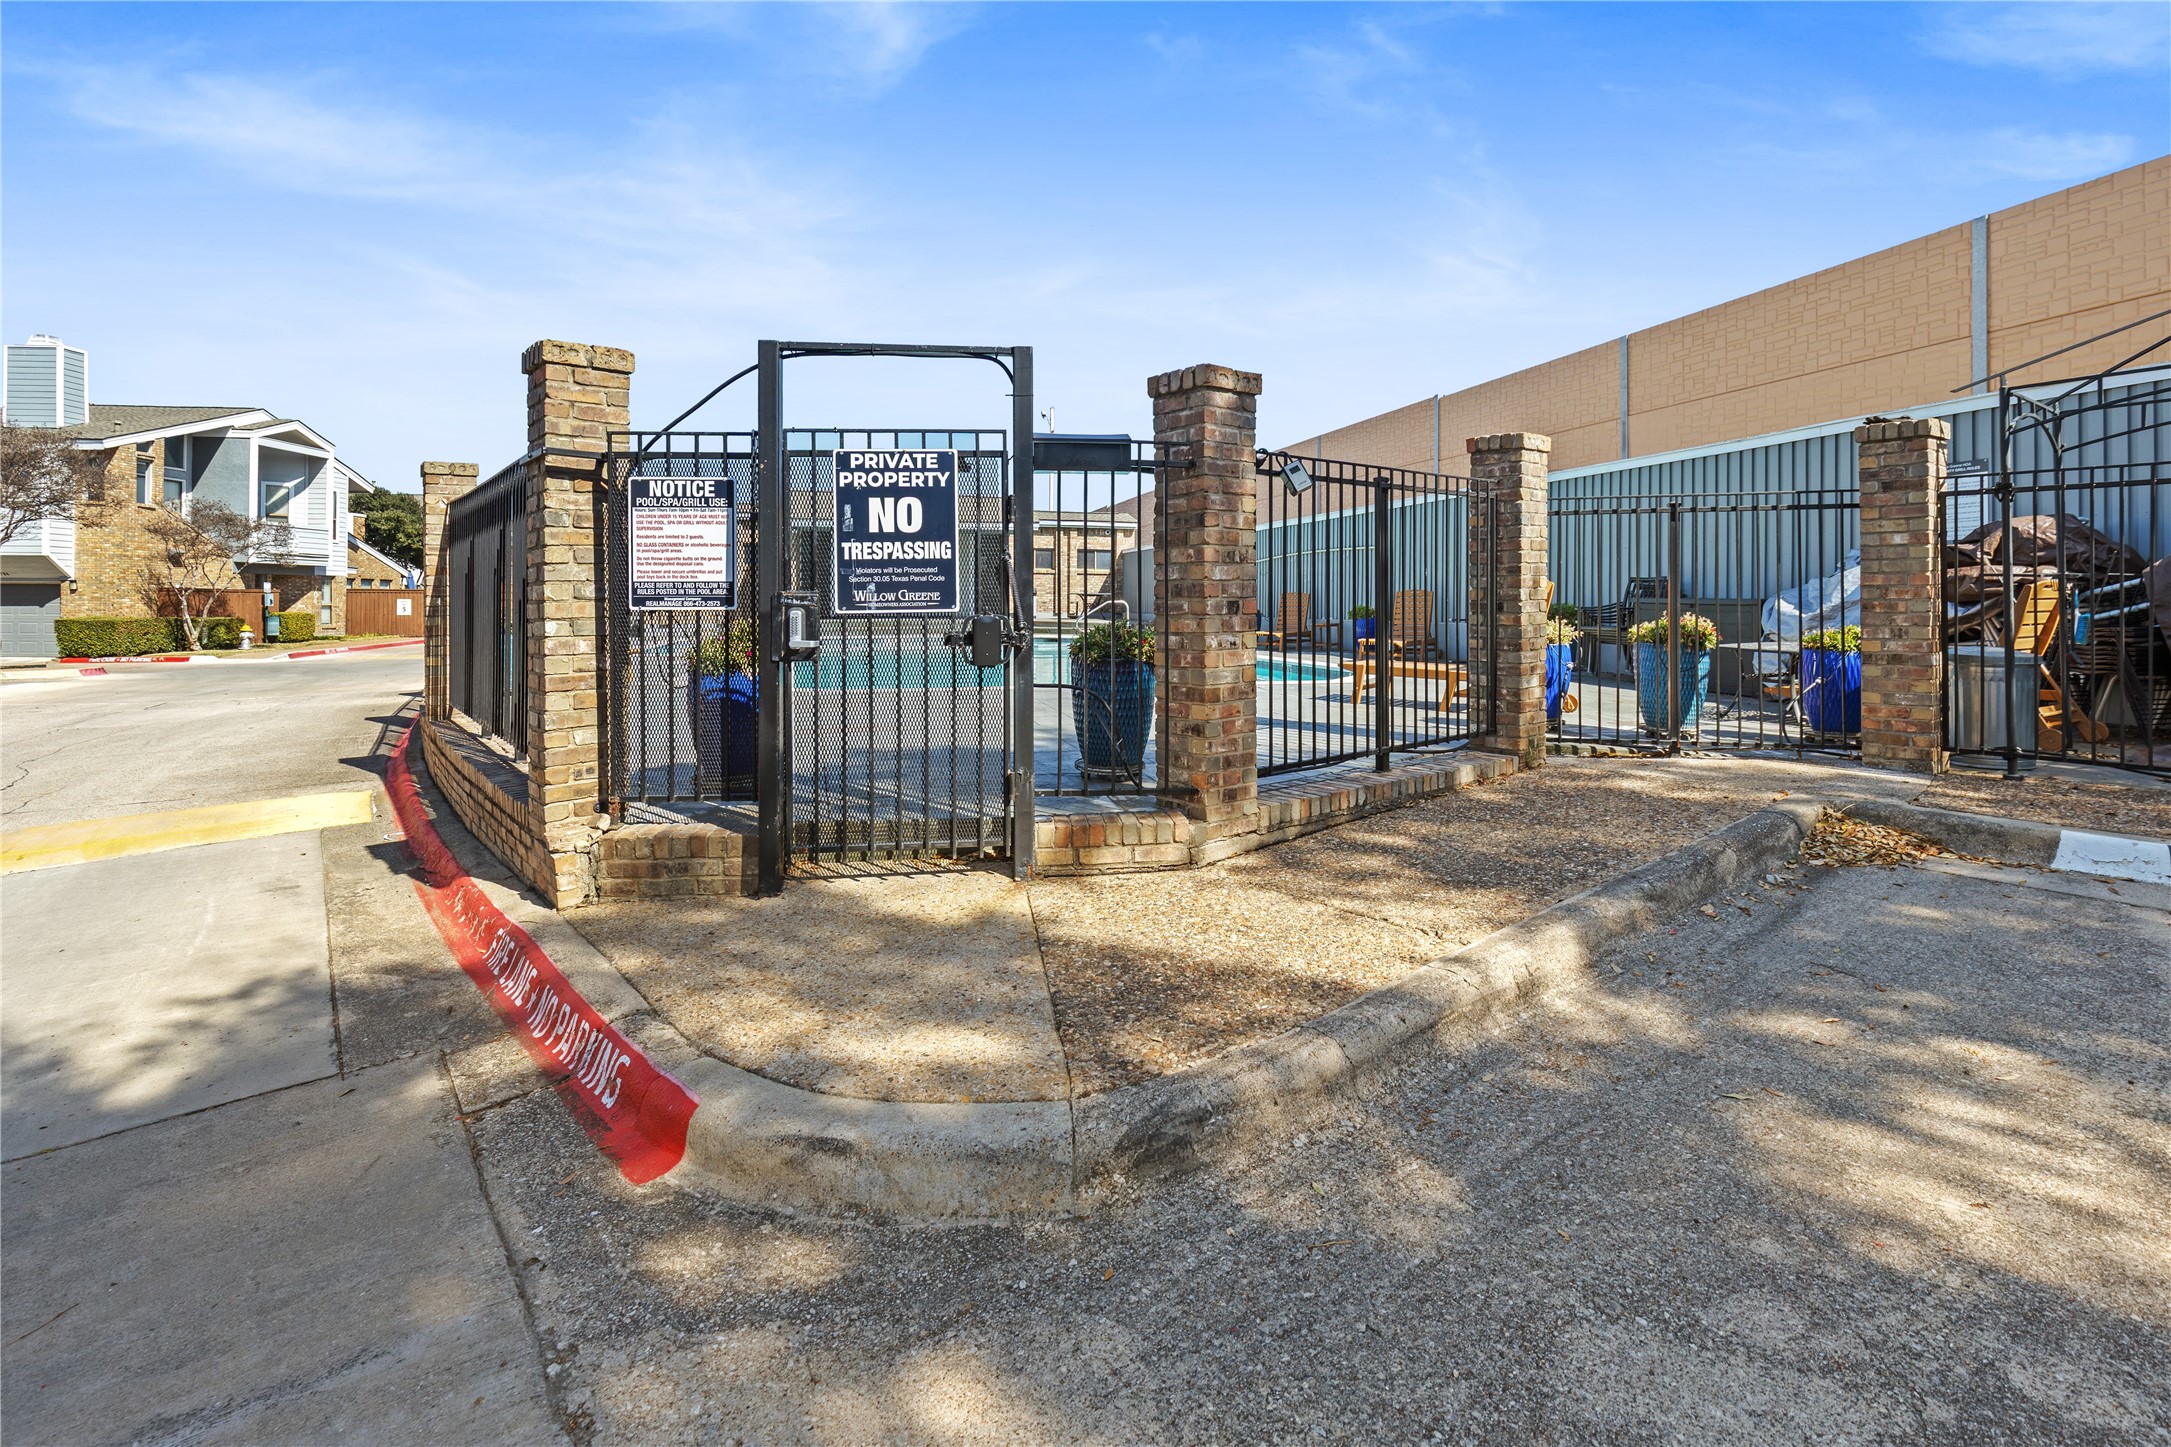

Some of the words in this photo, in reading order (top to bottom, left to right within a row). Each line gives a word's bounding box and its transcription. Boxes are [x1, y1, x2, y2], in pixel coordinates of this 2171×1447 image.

[850, 453, 938, 468] PRIVATE
[839, 471, 950, 487] PROPERTY
[649, 480, 715, 497] NOTICE
[636, 498, 707, 506] POOL/SPA/GRILL
[709, 498, 728, 506] USE:
[868, 496, 923, 533] NO
[841, 541, 952, 560] TRESPASSING
[854, 590, 896, 601] WILLOW
[898, 590, 941, 600] GREENE
[482, 928, 515, 976] FIRE
[499, 948, 538, 1007] LANE
[527, 984, 559, 1038] NO
[544, 1003, 631, 1109] PARKING
